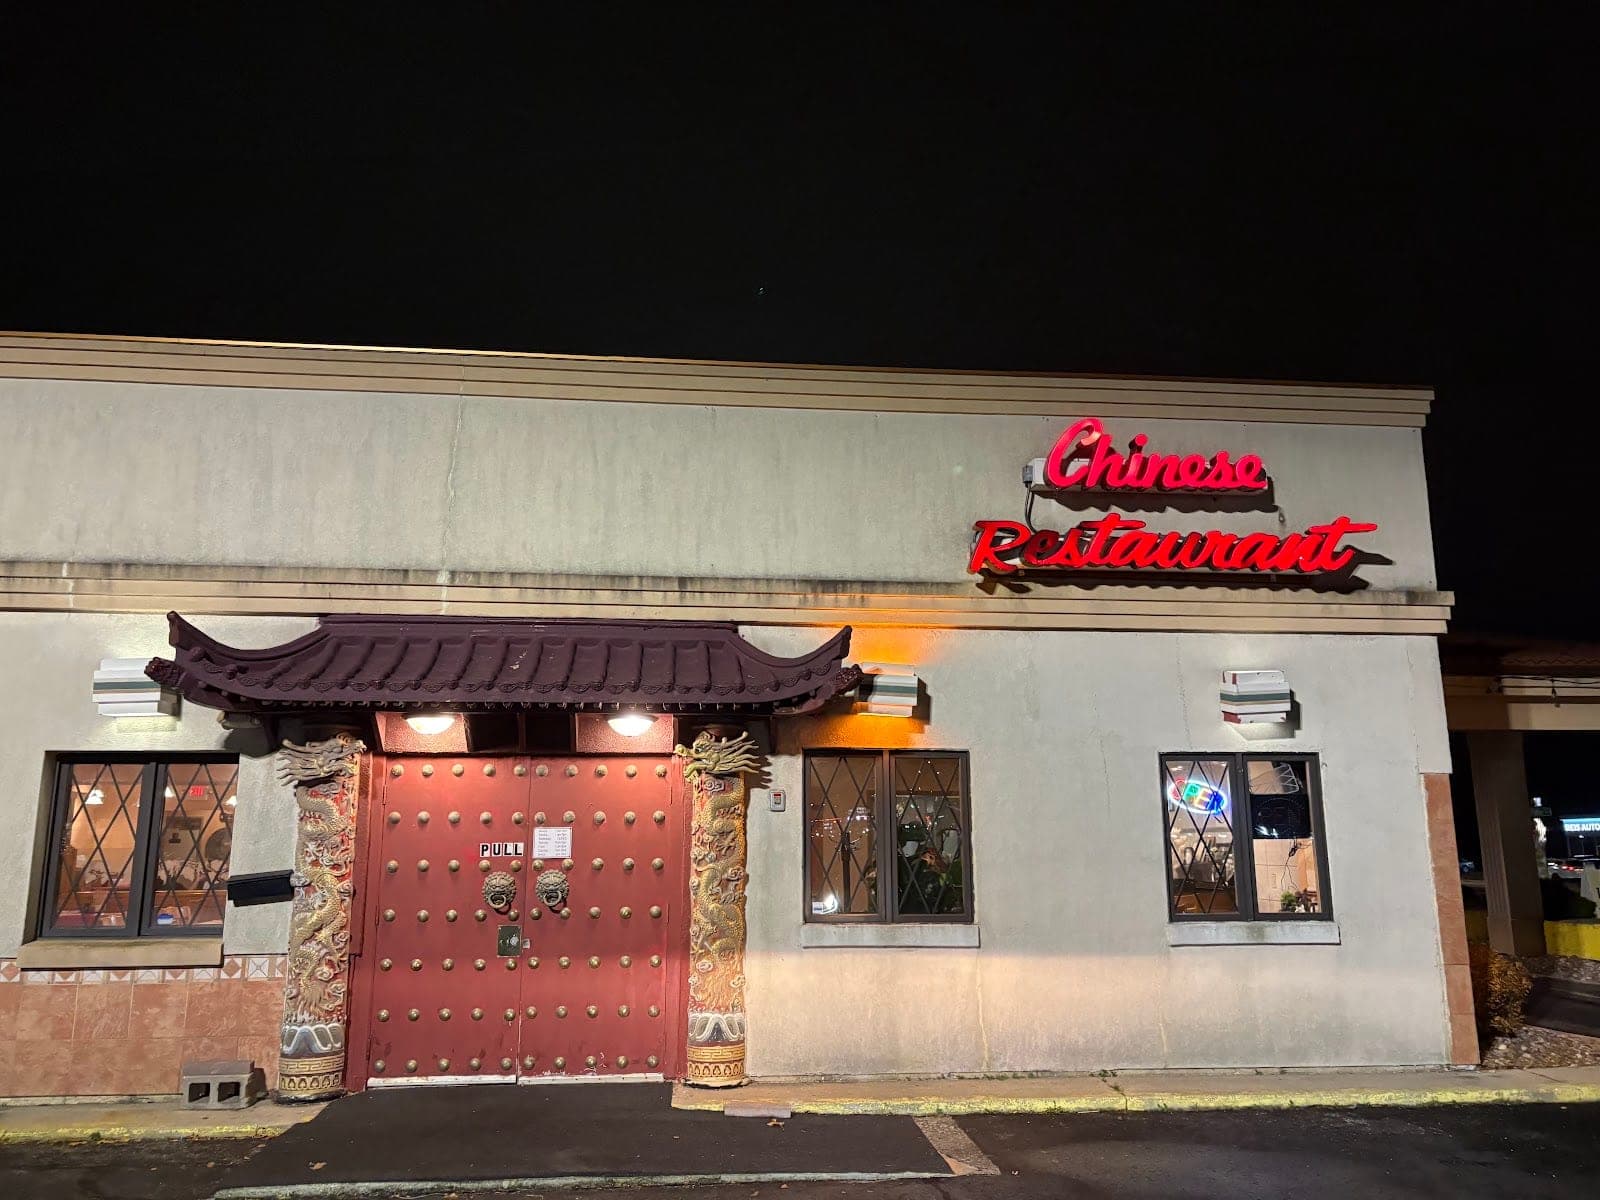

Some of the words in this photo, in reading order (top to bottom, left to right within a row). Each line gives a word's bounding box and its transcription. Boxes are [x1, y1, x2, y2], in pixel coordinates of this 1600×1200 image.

[1046, 417, 1267, 490] Chinese
[968, 512, 1378, 573] Restaurant
[481, 843, 522, 856] PULL
